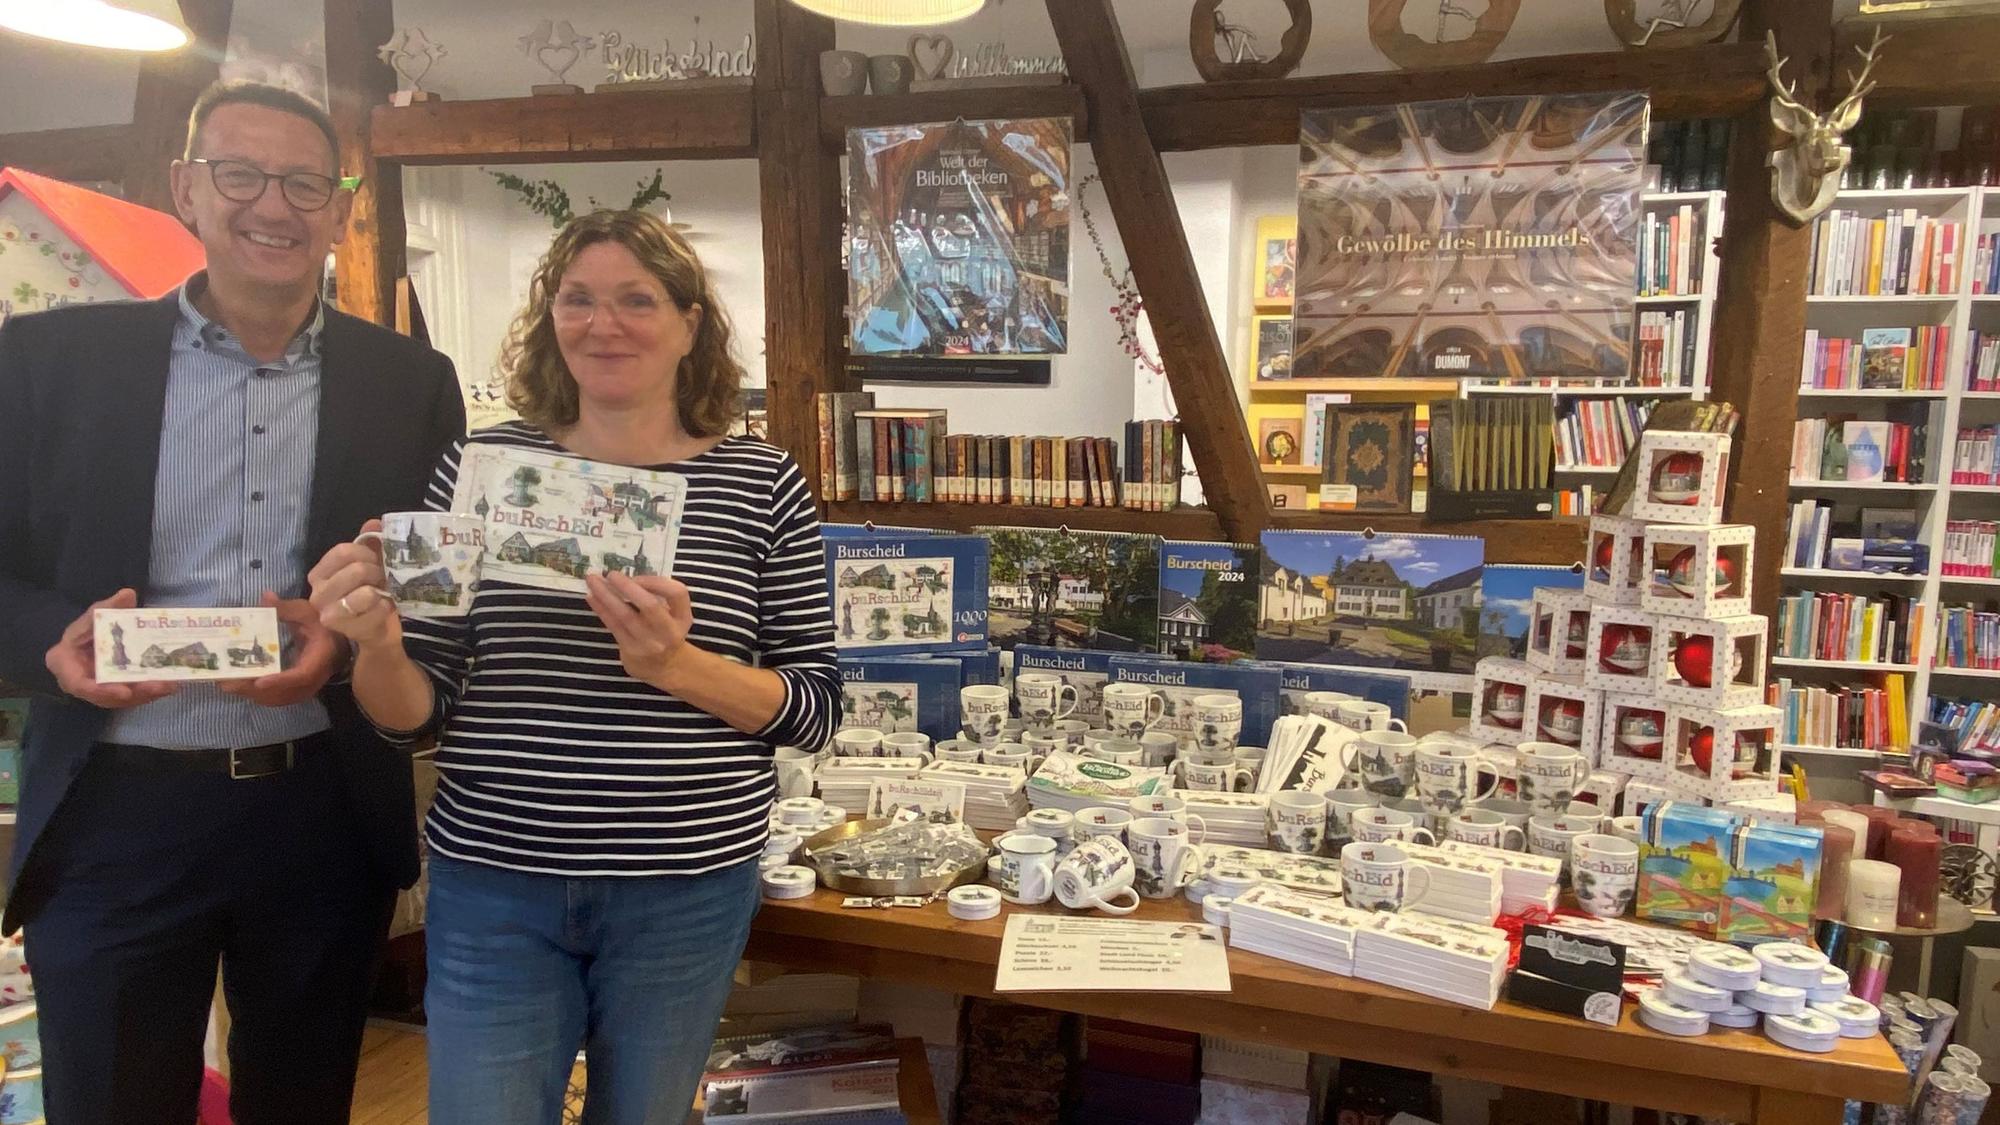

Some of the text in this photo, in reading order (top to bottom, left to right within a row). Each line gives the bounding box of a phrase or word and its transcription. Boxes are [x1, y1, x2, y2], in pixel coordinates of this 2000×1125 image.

[940, 155, 988, 168] Welt der
[916, 169, 1008, 187] Bibliotheken
[1336, 227, 1590, 254] Gewölbe des Himmels
[1435, 355, 1472, 370] DUMONT
[837, 543, 905, 559] Burscheid
[1166, 556, 1233, 571] Burscheid
[1218, 571, 1245, 583] 2024
[953, 610, 988, 623] 1000
[1022, 653, 1086, 670] Burscheid
[1116, 667, 1186, 685] Burscheid
